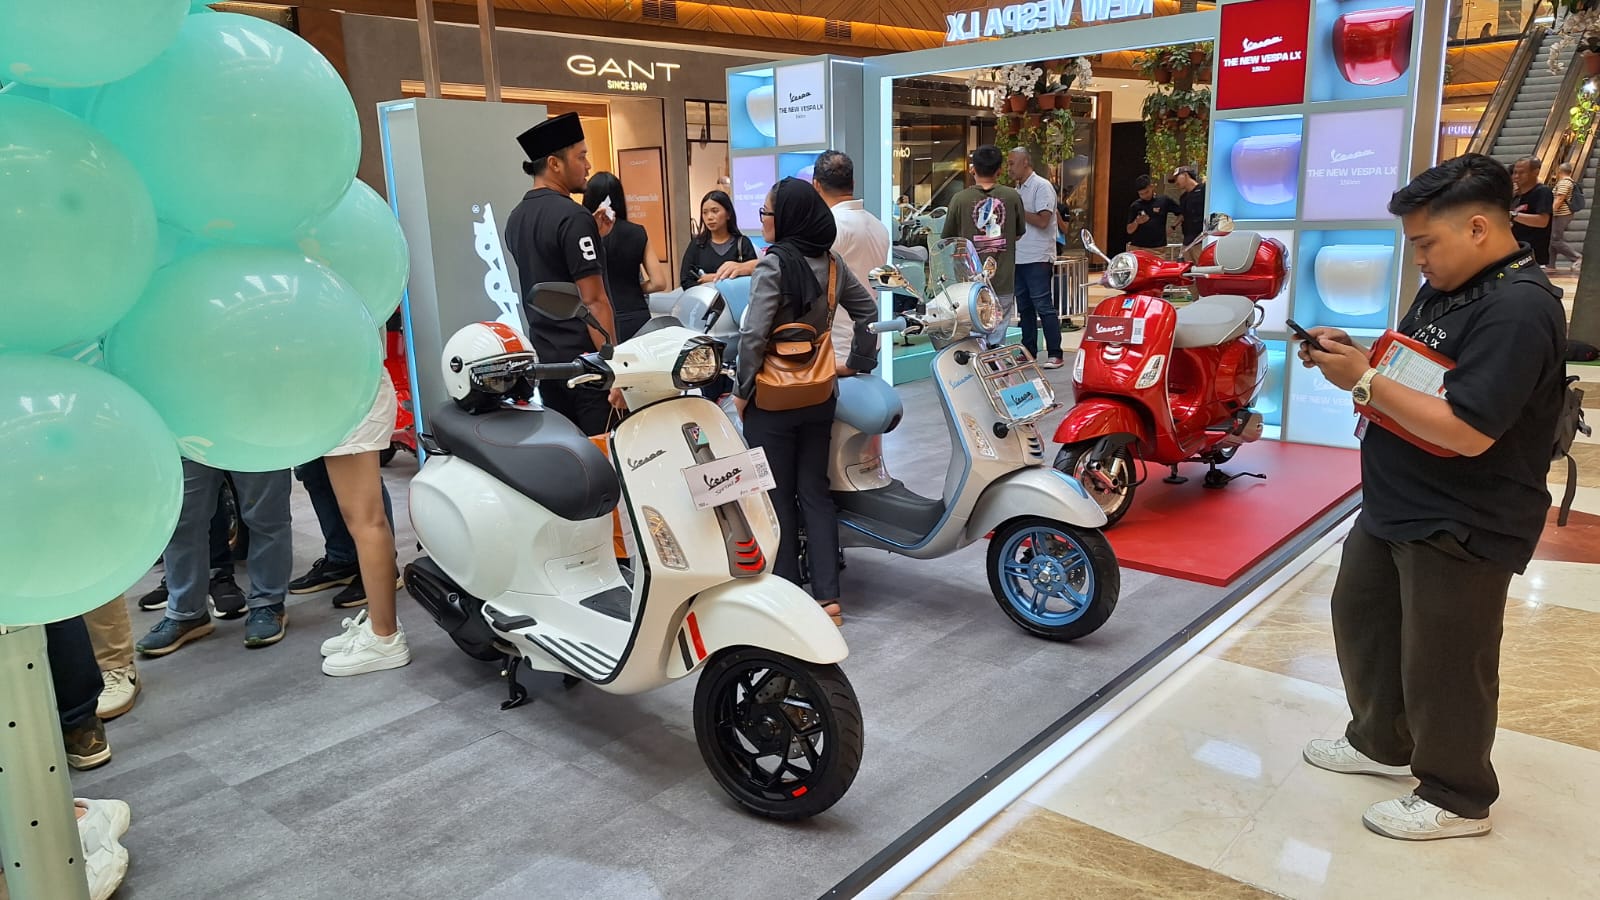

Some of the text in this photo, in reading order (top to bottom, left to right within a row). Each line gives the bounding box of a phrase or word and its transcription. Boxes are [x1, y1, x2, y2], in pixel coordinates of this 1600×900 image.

[567, 54, 681, 81] GANT
[1224, 51, 1301, 67] THE NEW VESPA LX
[607, 80, 647, 92] SINCE 1949
[801, 104, 817, 113] VESPA
[1307, 166, 1397, 177] THE NEW VESPA LX
[579, 236, 597, 260] 9
[627, 449, 669, 472] Vespa
[703, 467, 743, 491] Vespa
